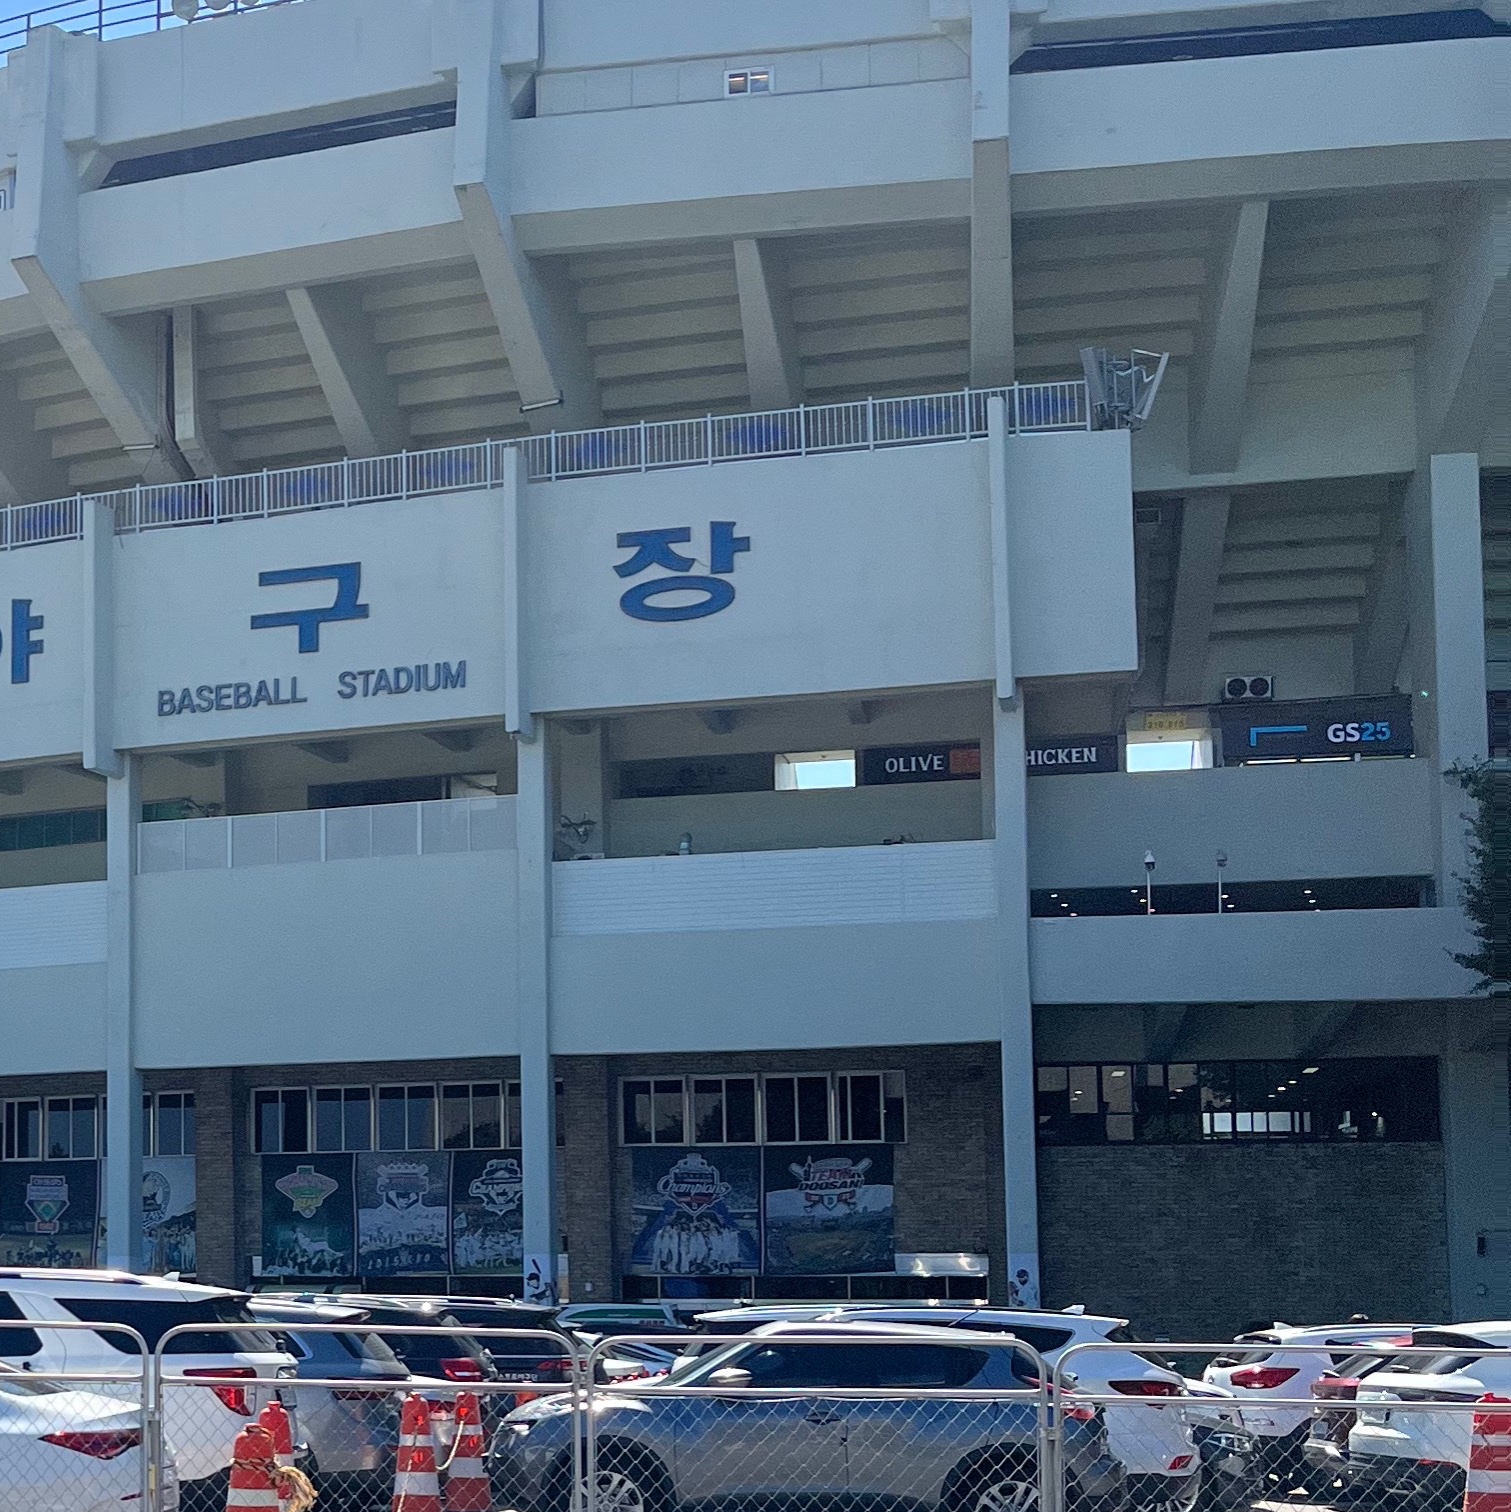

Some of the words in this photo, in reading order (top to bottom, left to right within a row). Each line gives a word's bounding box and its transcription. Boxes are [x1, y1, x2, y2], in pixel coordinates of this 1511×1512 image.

[249, 560, 370, 654] 구
[611, 520, 752, 623] 장
[157, 676, 307, 717] BASEBALL
[337, 660, 468, 701] STADIUM
[1326, 721, 1391, 743] GS25
[884, 753, 945, 773] OLIVE
[1025, 747, 1098, 767] HICKEN
